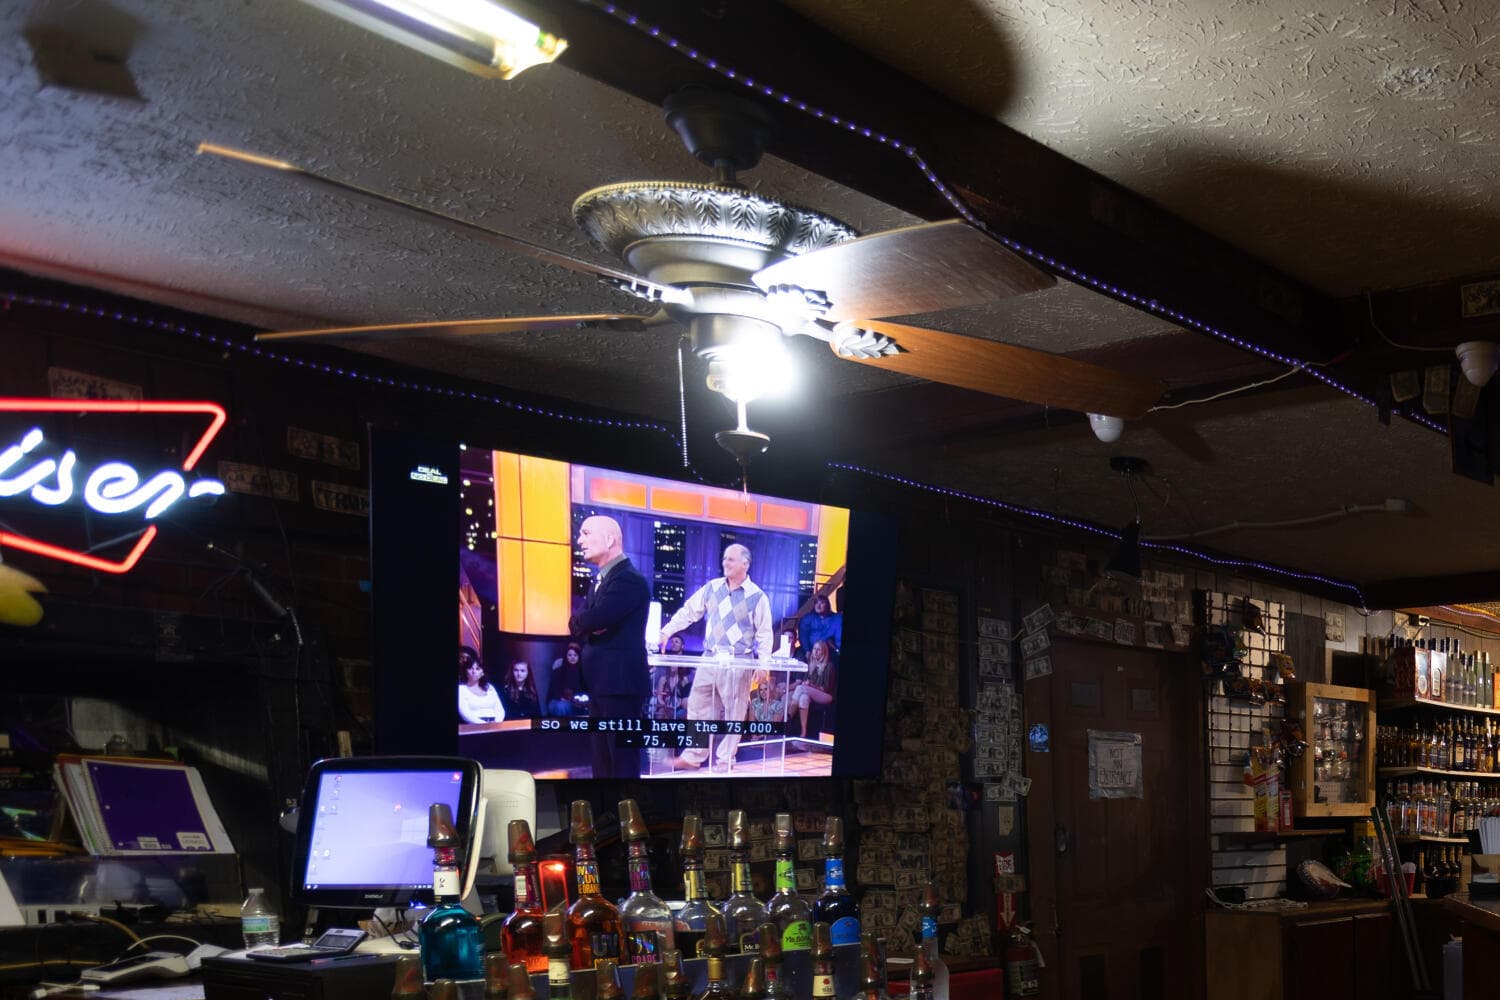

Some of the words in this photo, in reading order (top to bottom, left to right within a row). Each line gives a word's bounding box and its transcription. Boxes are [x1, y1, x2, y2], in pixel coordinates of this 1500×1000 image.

[541, 719, 560, 730] so
[570, 720, 588, 730] we
[598, 719, 642, 731] still
[651, 721, 685, 732] have
[695, 723, 718, 732] the
[726, 723, 778, 734] 75,000.
[677, 736, 700, 746] 75.
